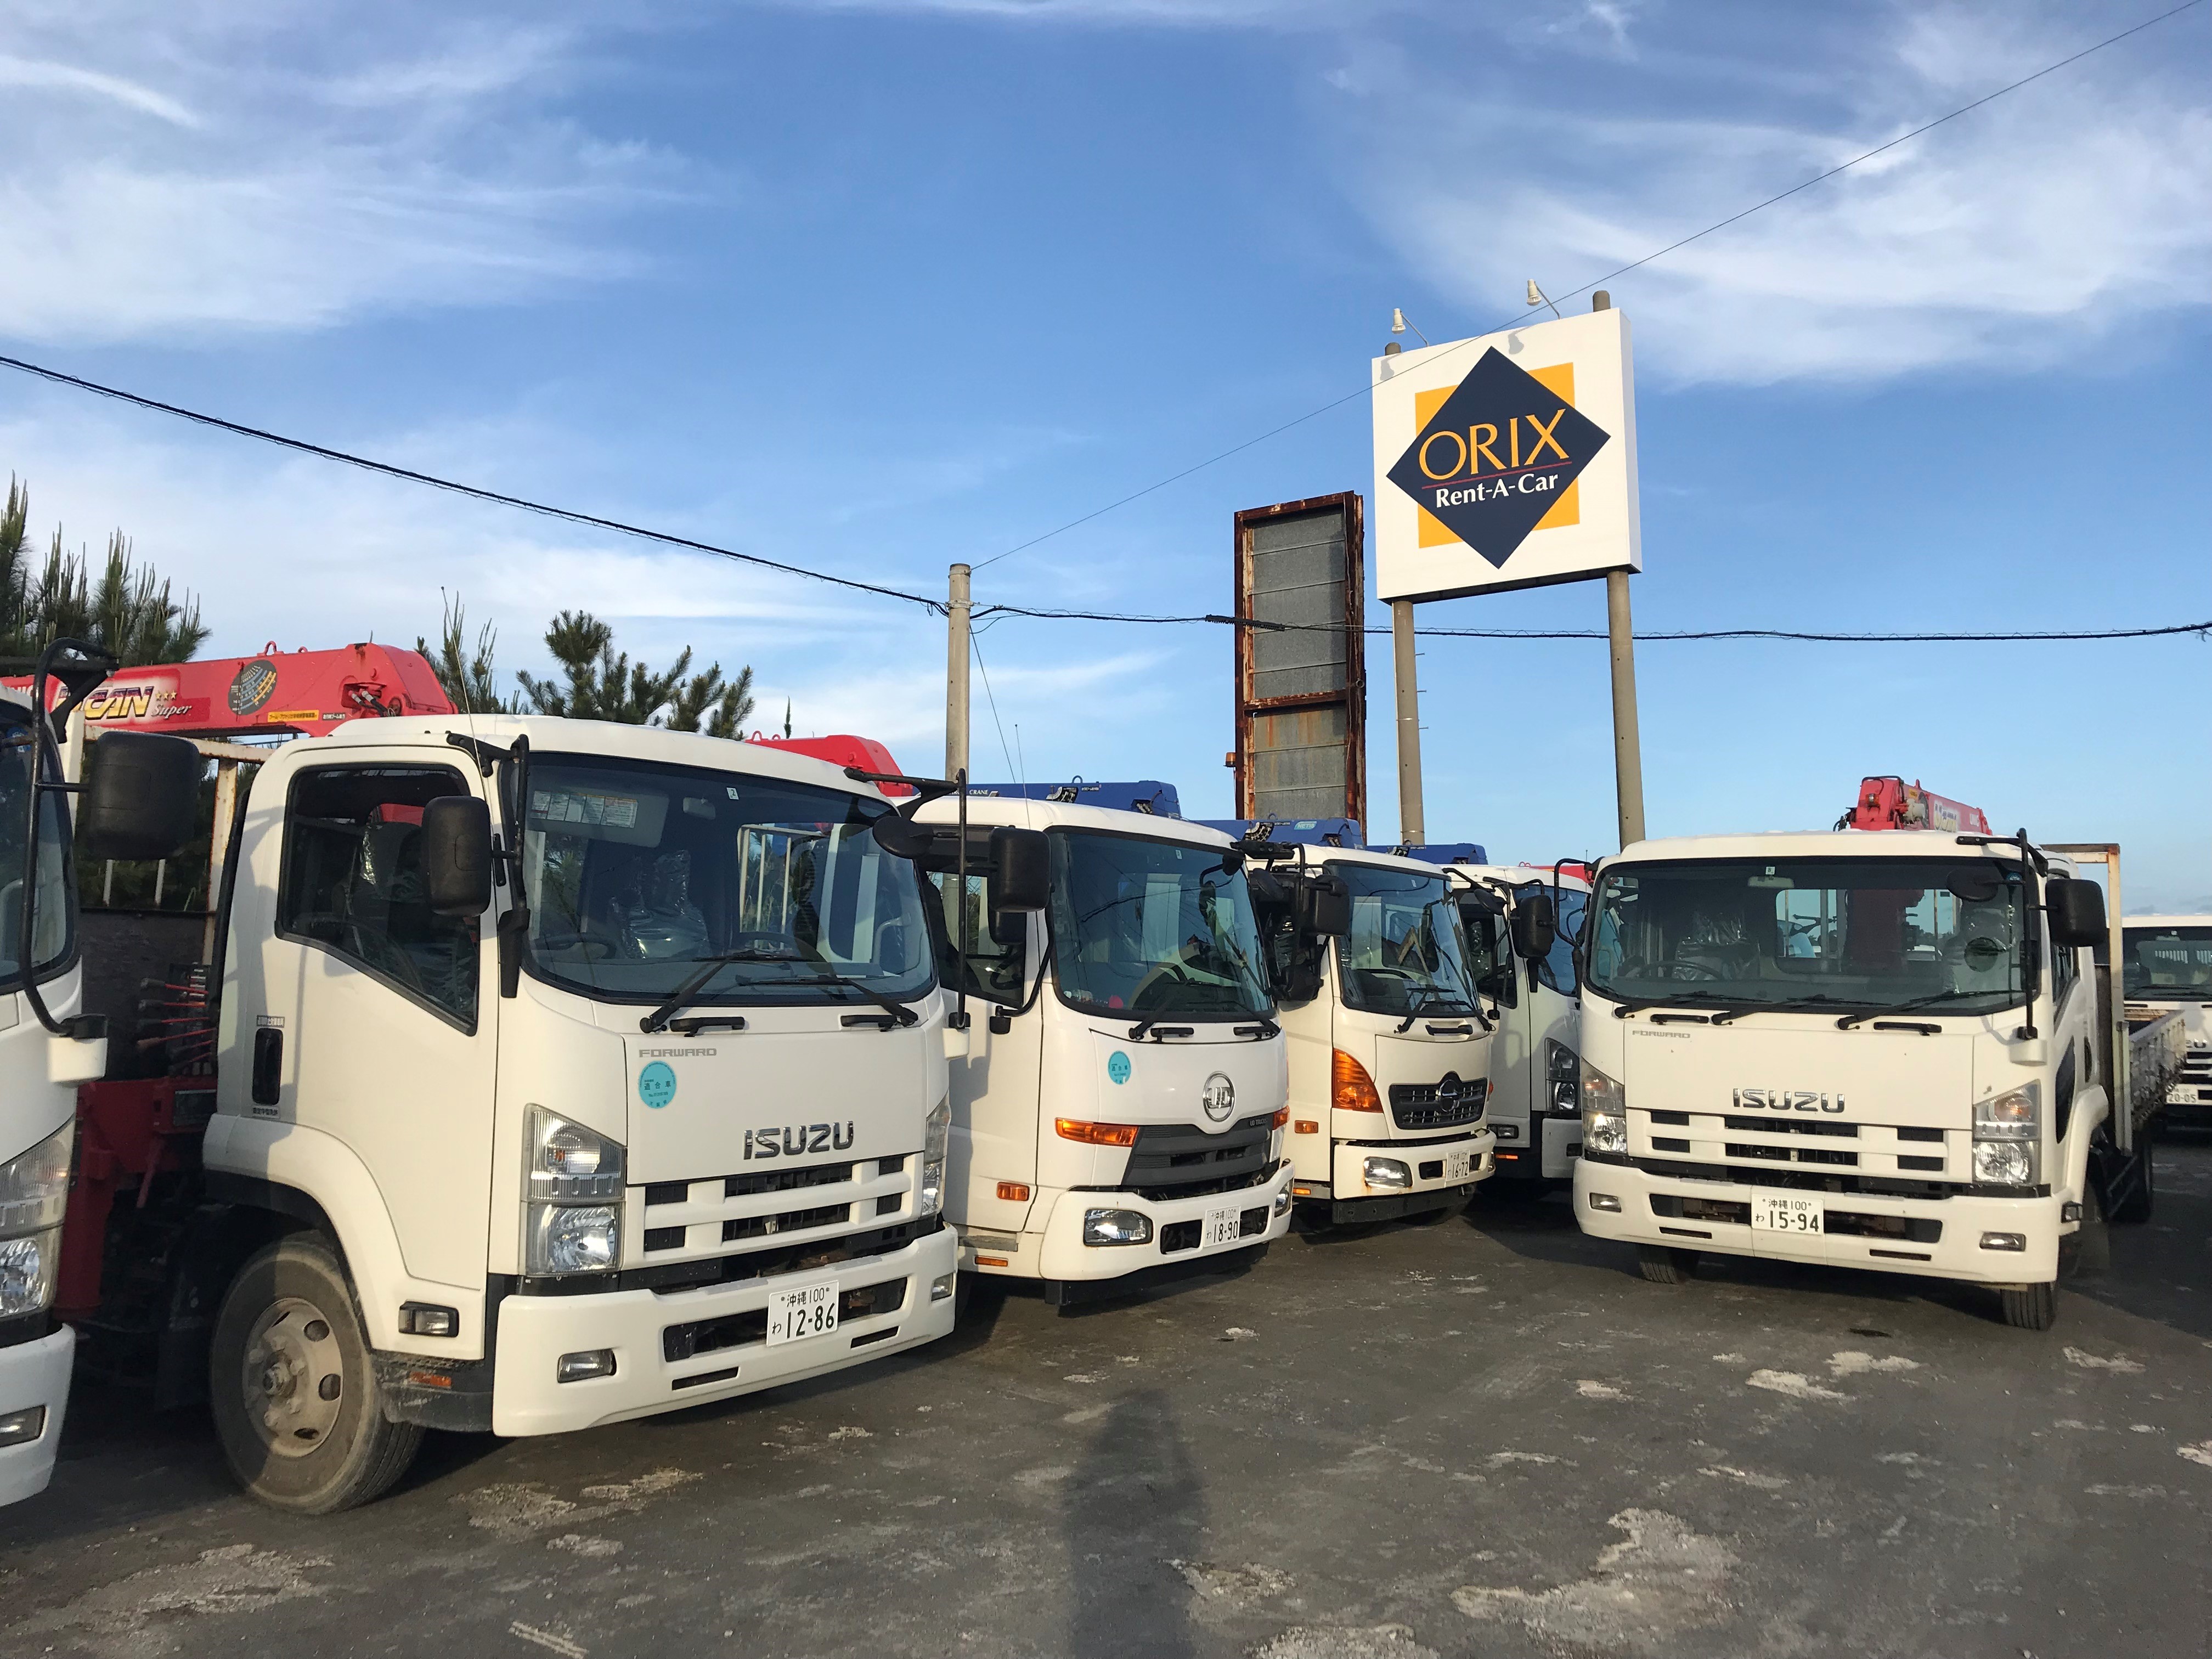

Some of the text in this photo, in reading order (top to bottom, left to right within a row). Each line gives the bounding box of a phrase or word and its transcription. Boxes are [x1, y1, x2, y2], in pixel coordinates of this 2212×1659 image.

[1419, 409, 1569, 480] ORIX
[1436, 473, 1558, 508] Rent-A-Car
[151, 704, 193, 720] Super
[1632, 1030, 1691, 1039] FORWARD
[639, 1048, 717, 1058] FORWARD
[1733, 1088, 1845, 1113] ISUZU
[743, 1120, 854, 1160] ISUZU
[1452, 1161, 1469, 1178] 16-72
[1214, 1220, 1238, 1243] 18-90
[1770, 1210, 1819, 1232] 15-94
[771, 1302, 836, 1339] わ 12-86
